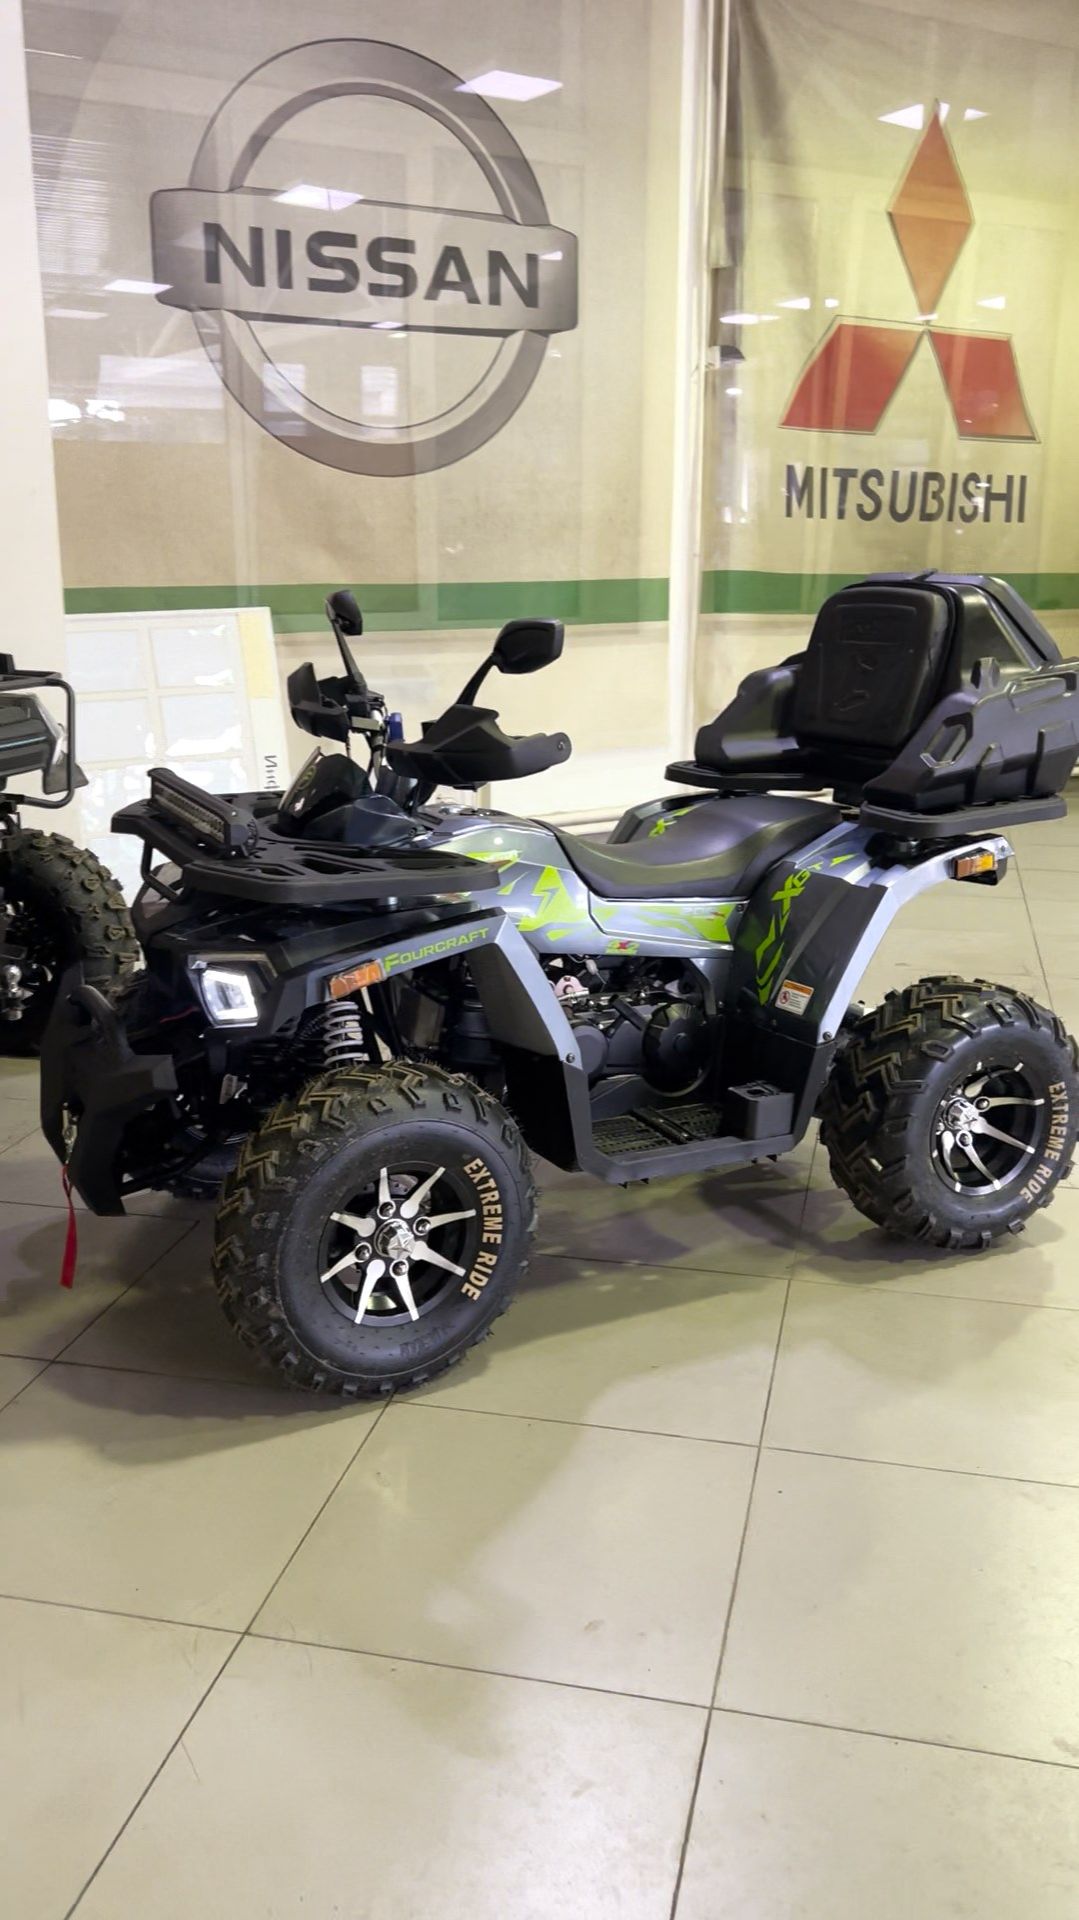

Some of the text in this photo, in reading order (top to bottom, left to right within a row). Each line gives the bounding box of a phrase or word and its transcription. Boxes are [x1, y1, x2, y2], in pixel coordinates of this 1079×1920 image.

[203, 222, 539, 309] NISSAN
[785, 464, 1028, 524] MITSUBISHI
[384, 927, 490, 972] FOURCRAFT
[1020, 1081, 1069, 1204] EXTREME RIDE
[460, 1157, 504, 1301] EXTREME RIDE
